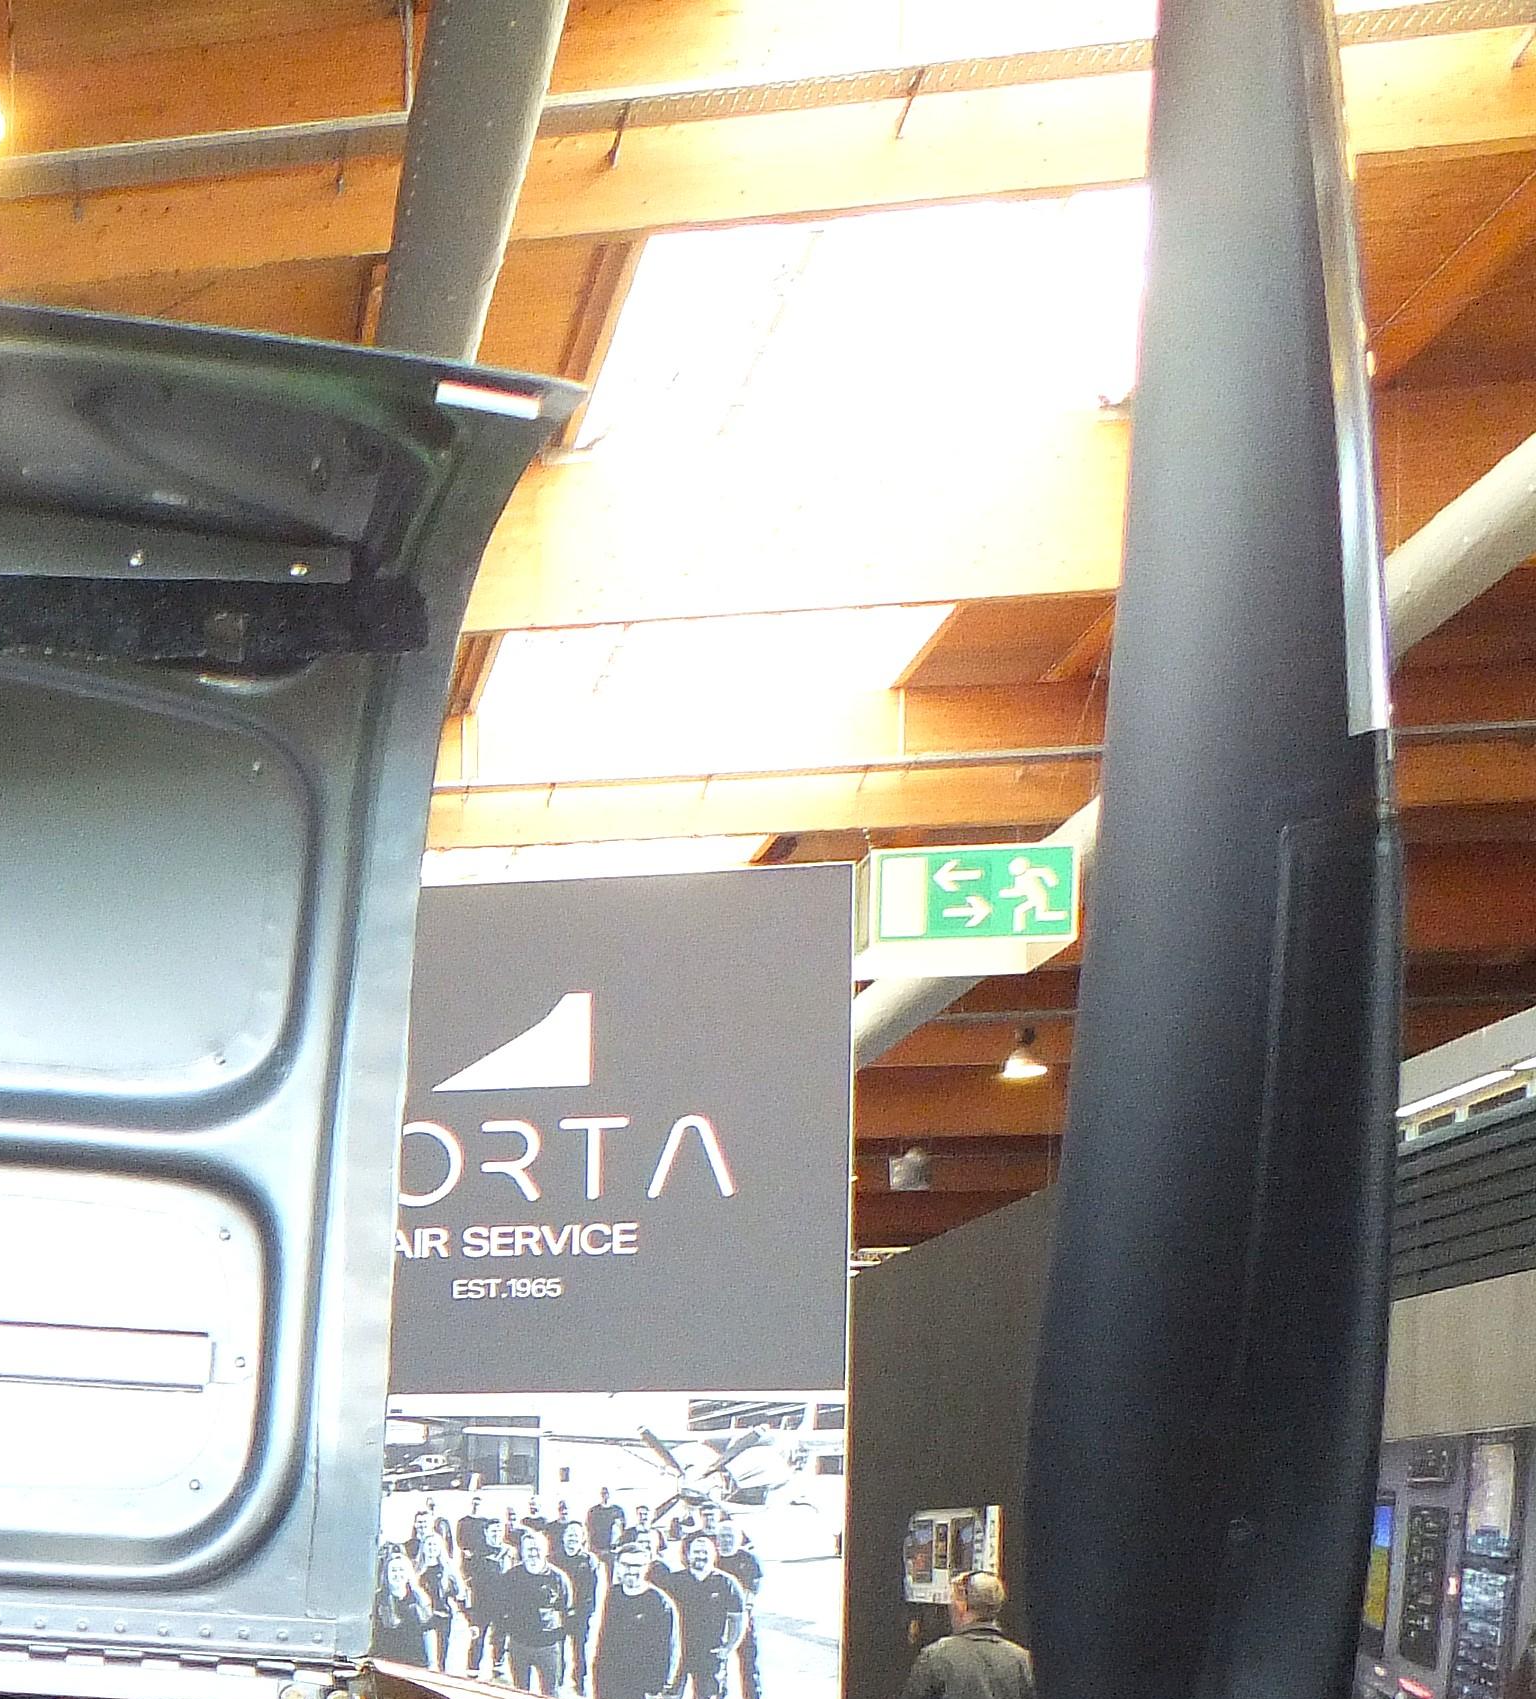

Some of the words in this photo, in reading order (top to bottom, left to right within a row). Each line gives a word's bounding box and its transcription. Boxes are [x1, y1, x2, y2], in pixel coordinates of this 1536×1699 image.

[393, 1227, 449, 1259] AIR
[461, 1222, 639, 1258] SERVICE
[452, 1277, 562, 1299] EST.1965
